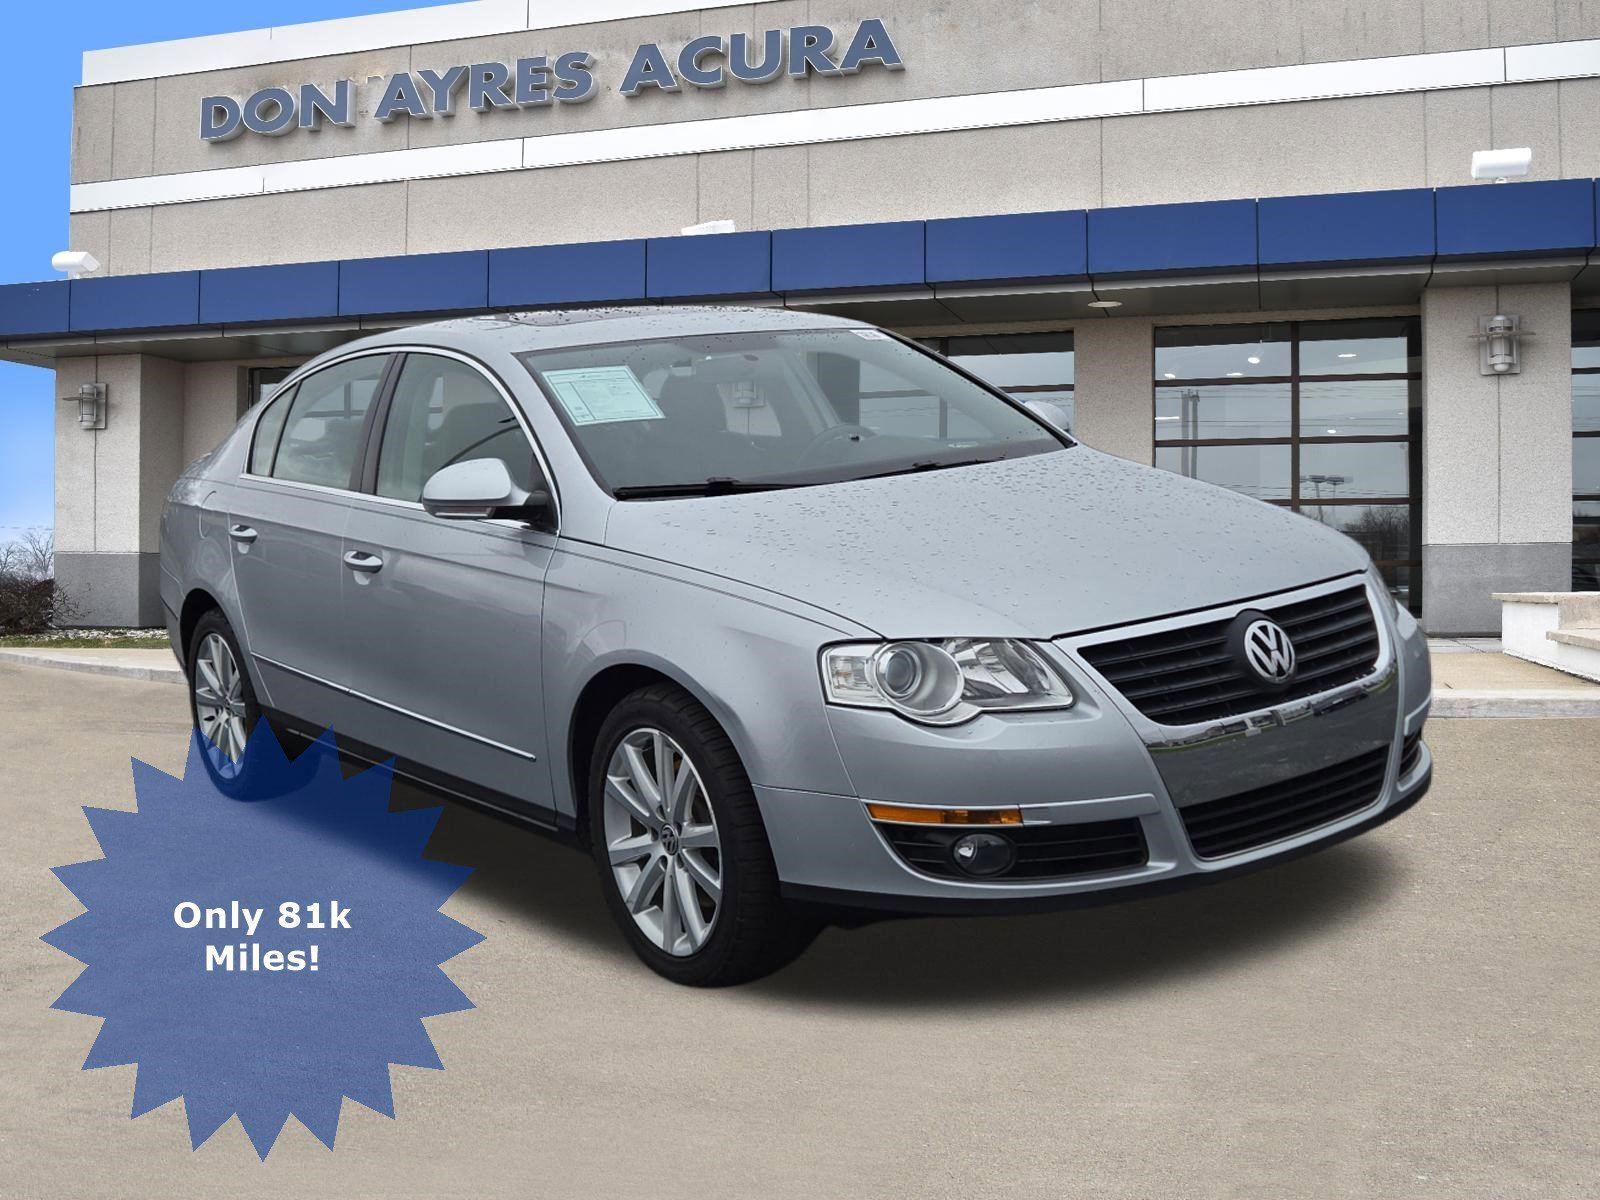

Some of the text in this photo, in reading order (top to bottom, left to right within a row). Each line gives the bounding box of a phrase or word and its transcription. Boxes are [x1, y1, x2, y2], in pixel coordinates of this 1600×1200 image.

[200, 18, 905, 142] DON AYRES ACURA
[1244, 620, 1295, 684] VW
